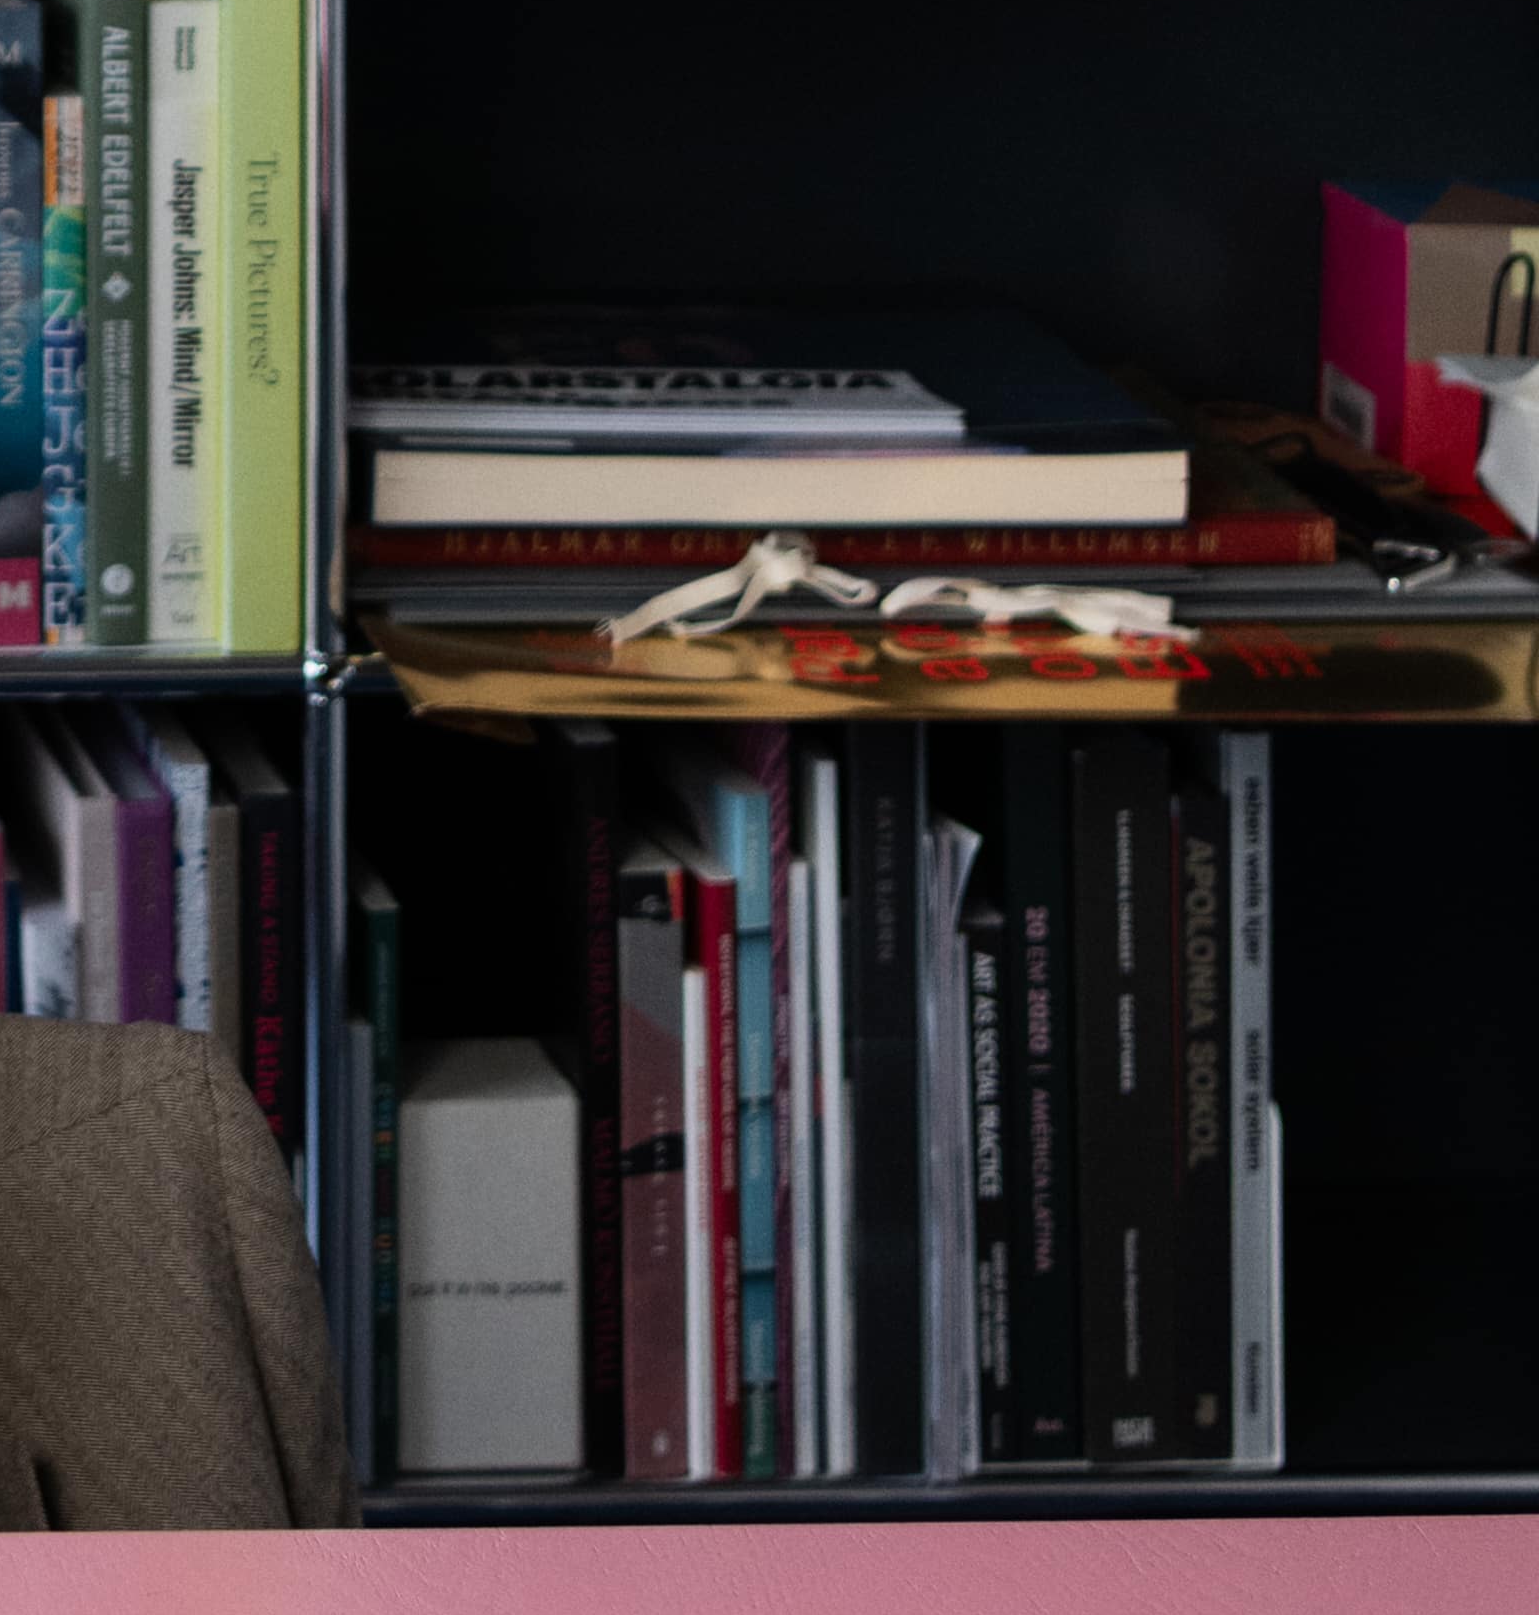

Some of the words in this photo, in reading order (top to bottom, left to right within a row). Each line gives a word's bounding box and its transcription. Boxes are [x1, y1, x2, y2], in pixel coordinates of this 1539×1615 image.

[101, 26, 131, 123] ALBERT
[102, 134, 132, 256] EDELFELT
[169, 158, 200, 234] Jasper
[247, 151, 279, 228] True
[171, 242, 200, 320] Johns:
[245, 238, 279, 386] Pictures?
[1187, 839, 1219, 1030] APOLONIA
